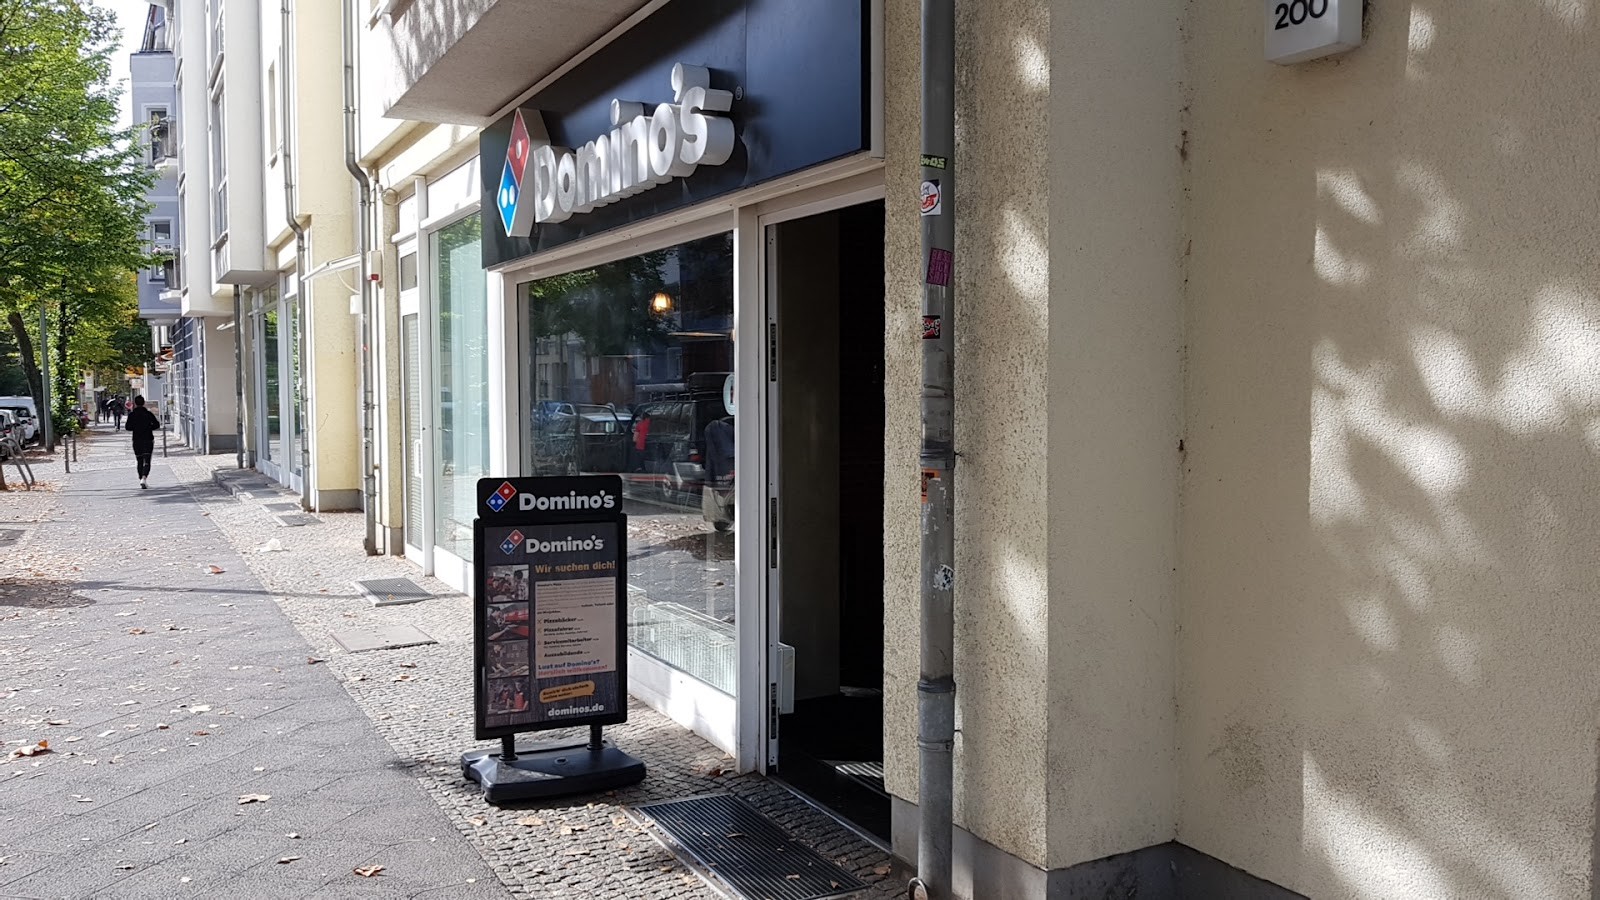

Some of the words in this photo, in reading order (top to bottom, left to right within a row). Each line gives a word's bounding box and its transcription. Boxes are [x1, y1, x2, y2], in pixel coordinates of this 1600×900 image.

[1275, 0, 1328, 30] 200
[534, 62, 733, 223] Domino's
[519, 490, 615, 511] Domino's
[525, 535, 604, 553] Domino's
[535, 564, 551, 573] Wir
[555, 562, 589, 572] suchen
[592, 560, 615, 570] dich!
[538, 662, 553, 670] Lust
[567, 659, 600, 668] Domino's?
[547, 703, 605, 717] dominos.de
